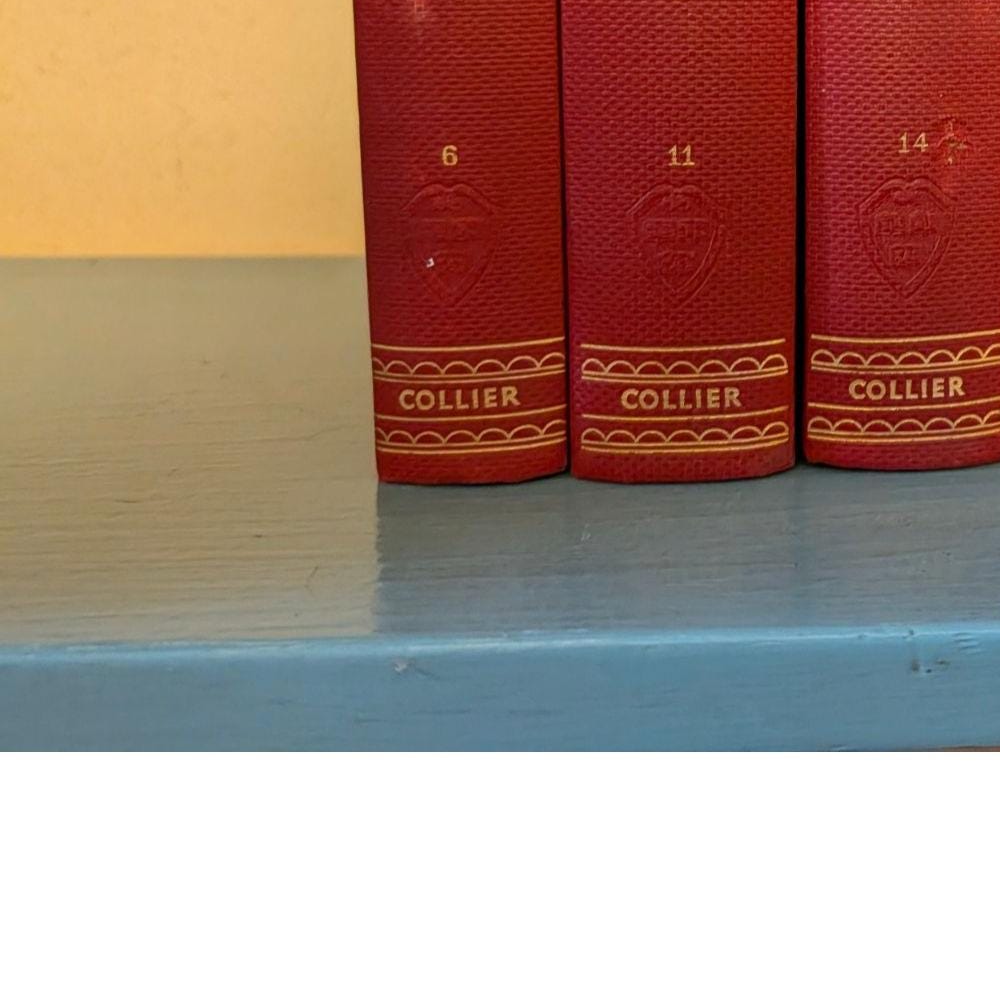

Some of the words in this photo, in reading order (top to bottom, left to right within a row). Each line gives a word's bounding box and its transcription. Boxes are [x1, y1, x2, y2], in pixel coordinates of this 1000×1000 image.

[899, 132, 930, 154] 14
[441, 145, 458, 167] 6
[668, 145, 696, 166] 11
[399, 386, 521, 411] COLLIER
[621, 387, 742, 411] COLLIER
[848, 374, 966, 402] COLLIER
